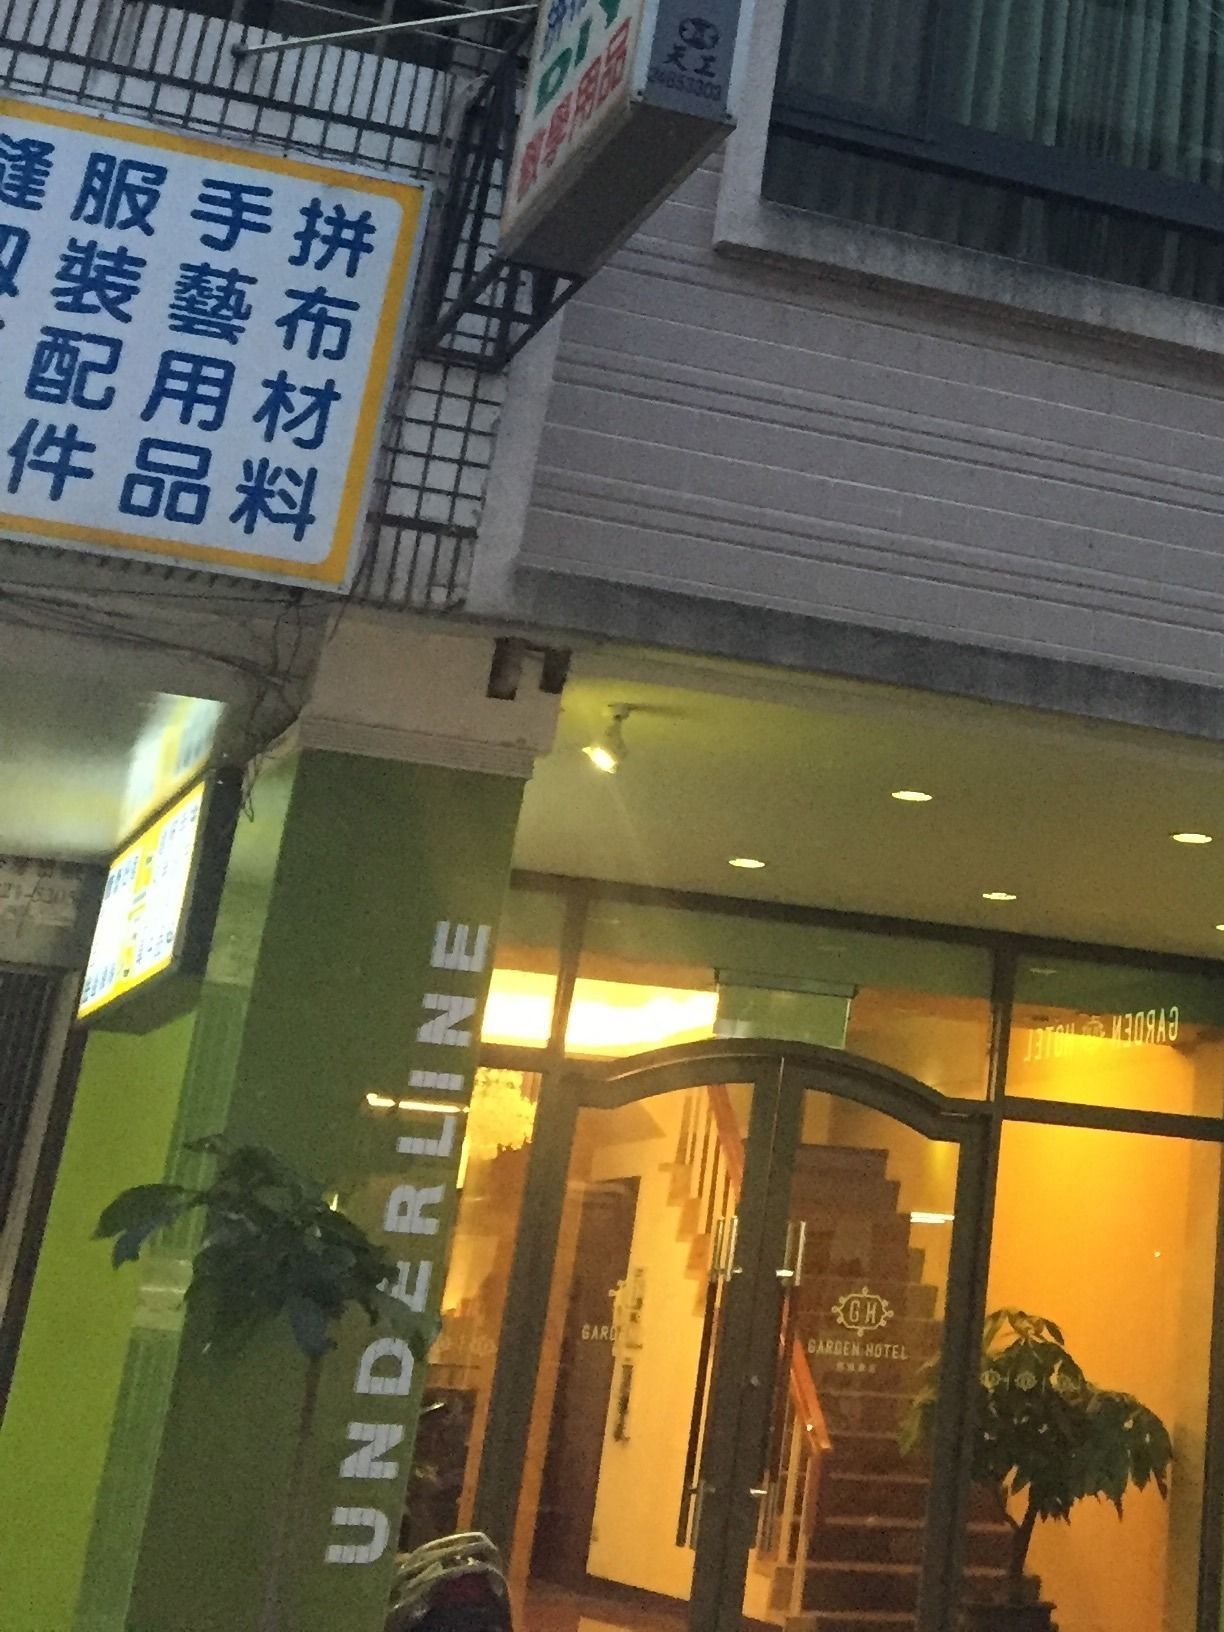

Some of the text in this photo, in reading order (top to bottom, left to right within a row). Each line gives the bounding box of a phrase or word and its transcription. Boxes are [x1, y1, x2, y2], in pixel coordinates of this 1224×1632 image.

[7, 152, 168, 501] 服裝配件
[118, 178, 273, 525] 手藝用品
[228, 197, 377, 542] 拼布材料
[325, 920, 492, 1565] UNDERLINE
[808, 1338, 908, 1360] GARDEN HOTEL
